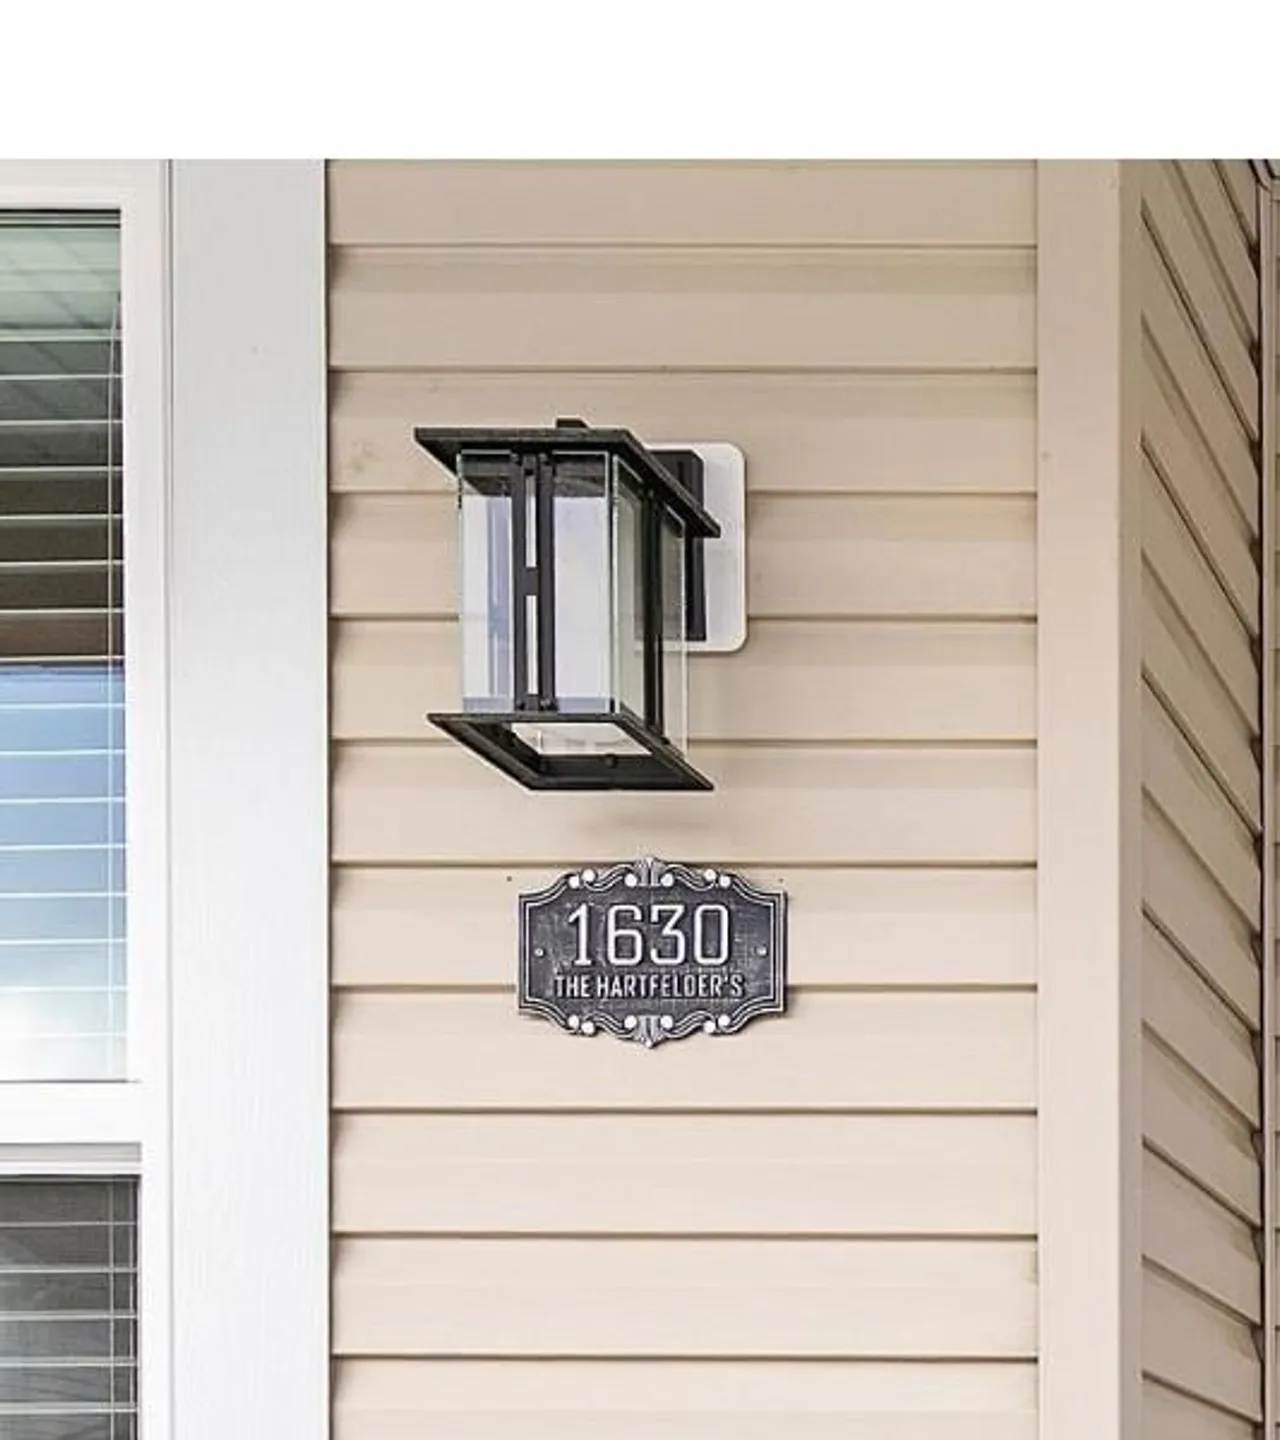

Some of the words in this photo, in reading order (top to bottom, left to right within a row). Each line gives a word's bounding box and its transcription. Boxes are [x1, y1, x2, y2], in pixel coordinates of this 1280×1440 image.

[568, 903, 729, 967] 1630
[555, 974, 590, 998] THE
[597, 974, 744, 998] HARTFELDER'S
